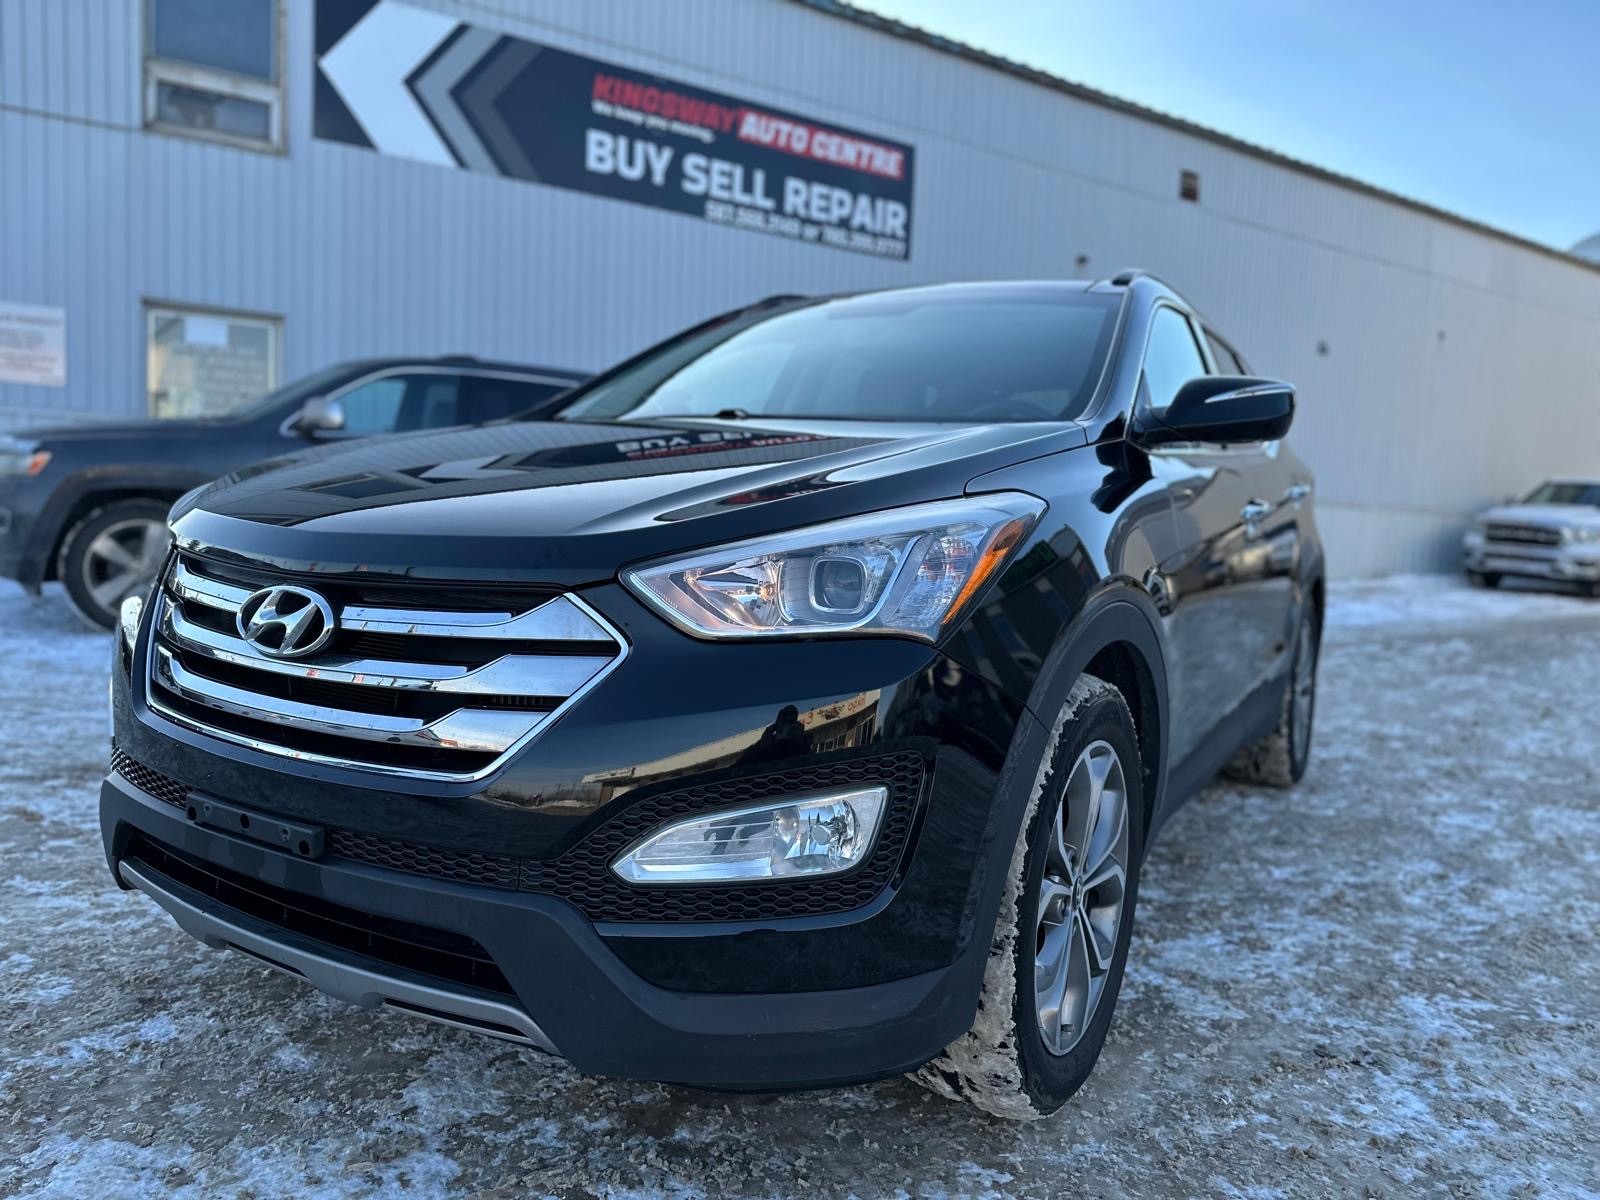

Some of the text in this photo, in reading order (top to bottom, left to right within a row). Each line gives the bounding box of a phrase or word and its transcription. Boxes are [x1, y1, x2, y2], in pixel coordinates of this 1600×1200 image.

[592, 73, 903, 177] KINGSWAY AUTO CENTRE
[585, 128, 674, 186] BUY
[681, 152, 776, 210] SELL
[784, 175, 907, 238] REPAIR
